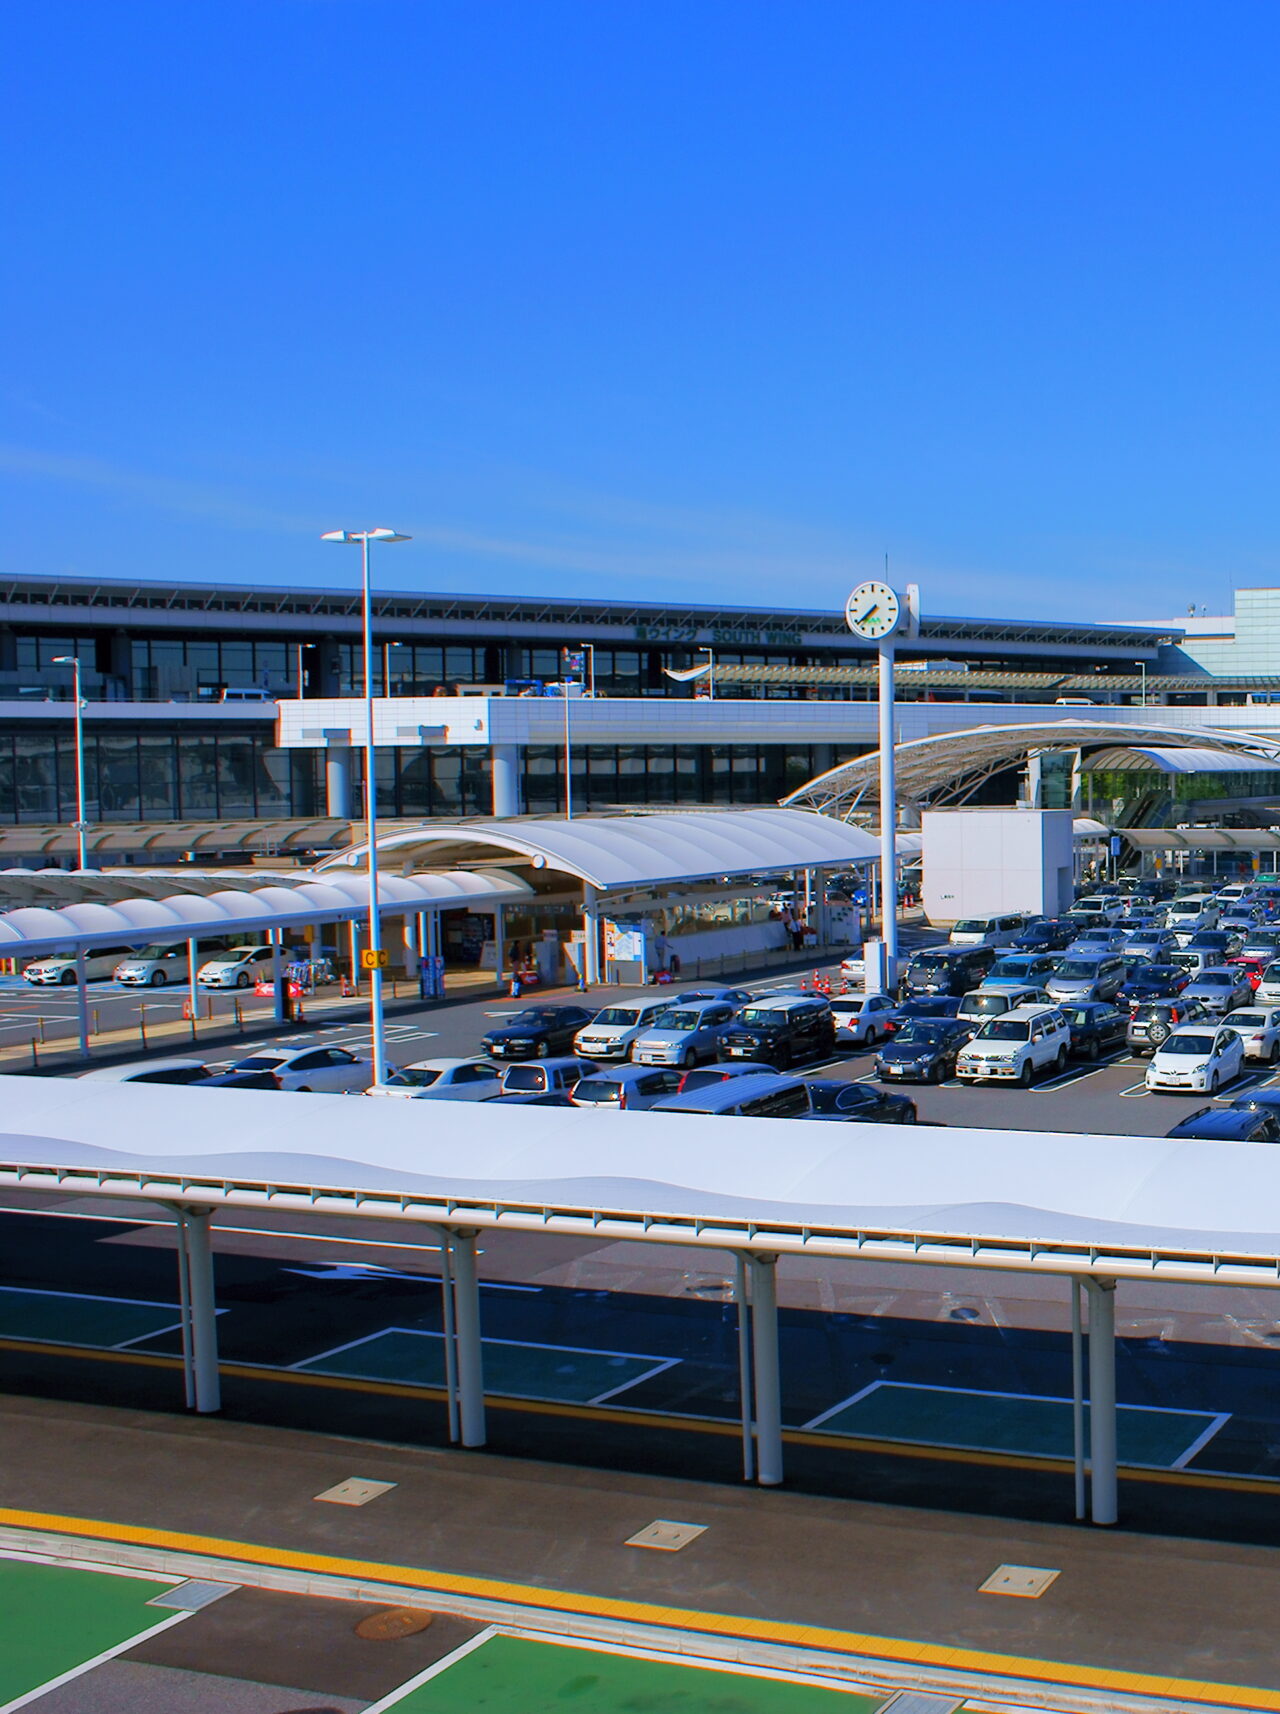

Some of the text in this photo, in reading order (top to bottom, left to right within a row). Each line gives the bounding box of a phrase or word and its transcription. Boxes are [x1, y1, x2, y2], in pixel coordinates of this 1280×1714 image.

[712, 630, 802, 645] SOUTH WING
[366, 952, 375, 966] C
